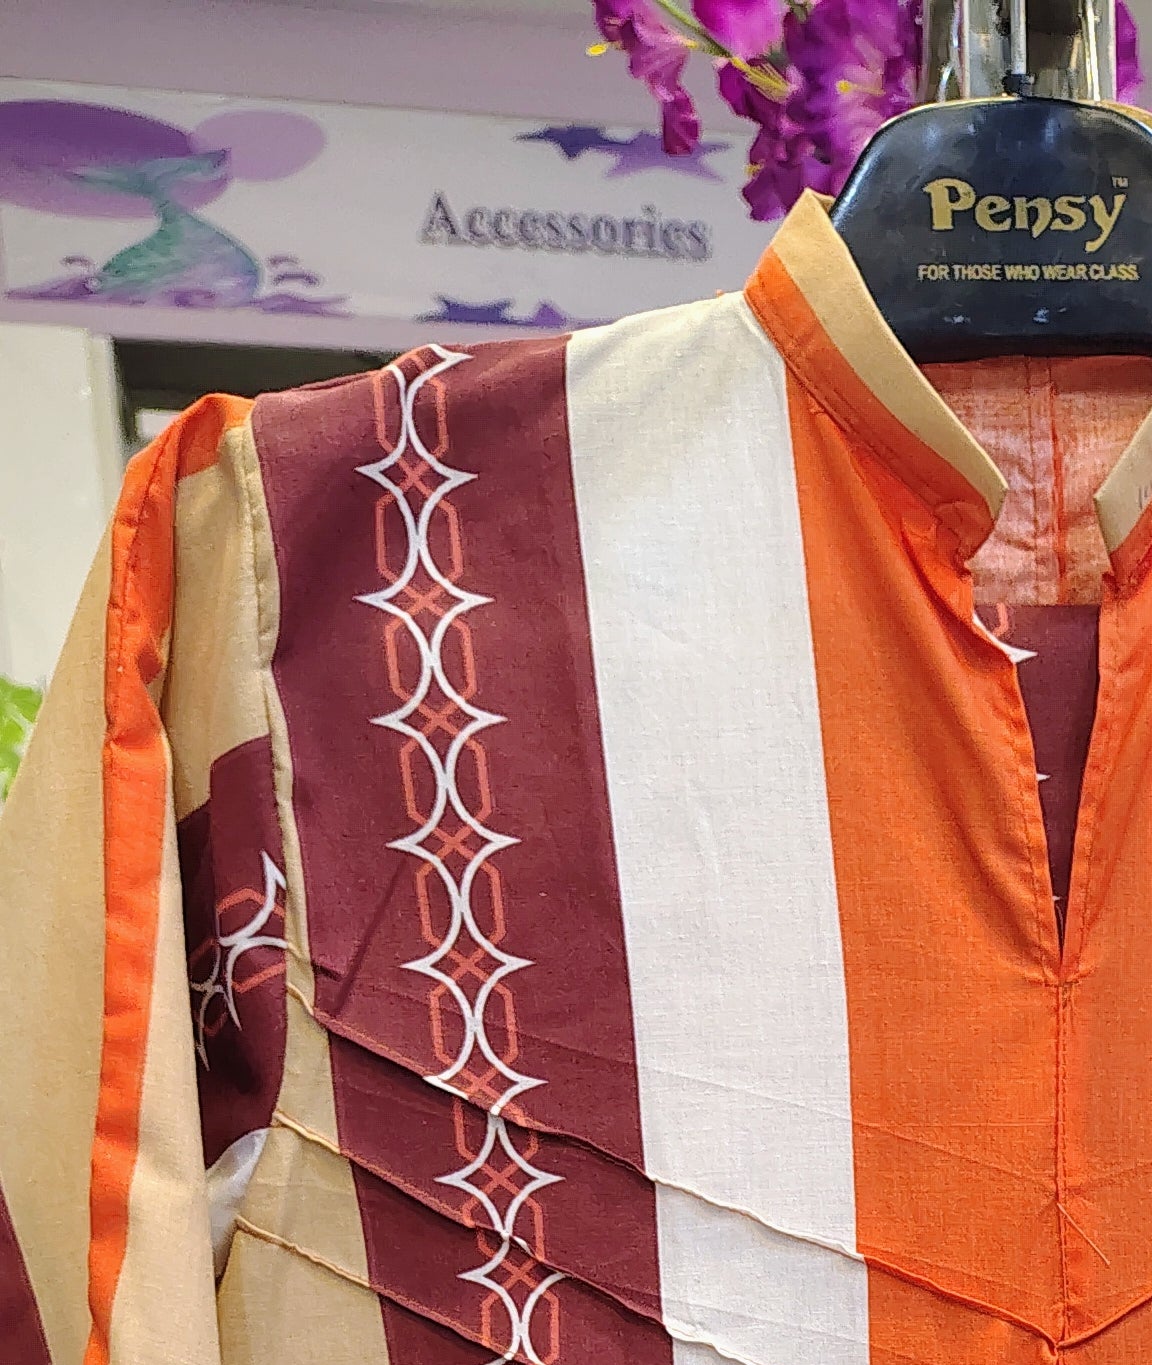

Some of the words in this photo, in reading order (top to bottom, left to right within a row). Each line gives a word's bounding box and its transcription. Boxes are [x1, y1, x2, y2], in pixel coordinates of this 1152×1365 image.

[417, 190, 712, 261] Accessories
[923, 178, 1127, 254] Pensy
[917, 264, 949, 281] FOR
[953, 264, 1001, 281] THOSE
[1004, 264, 1041, 281] WHO
[1043, 264, 1087, 281] WEAR
